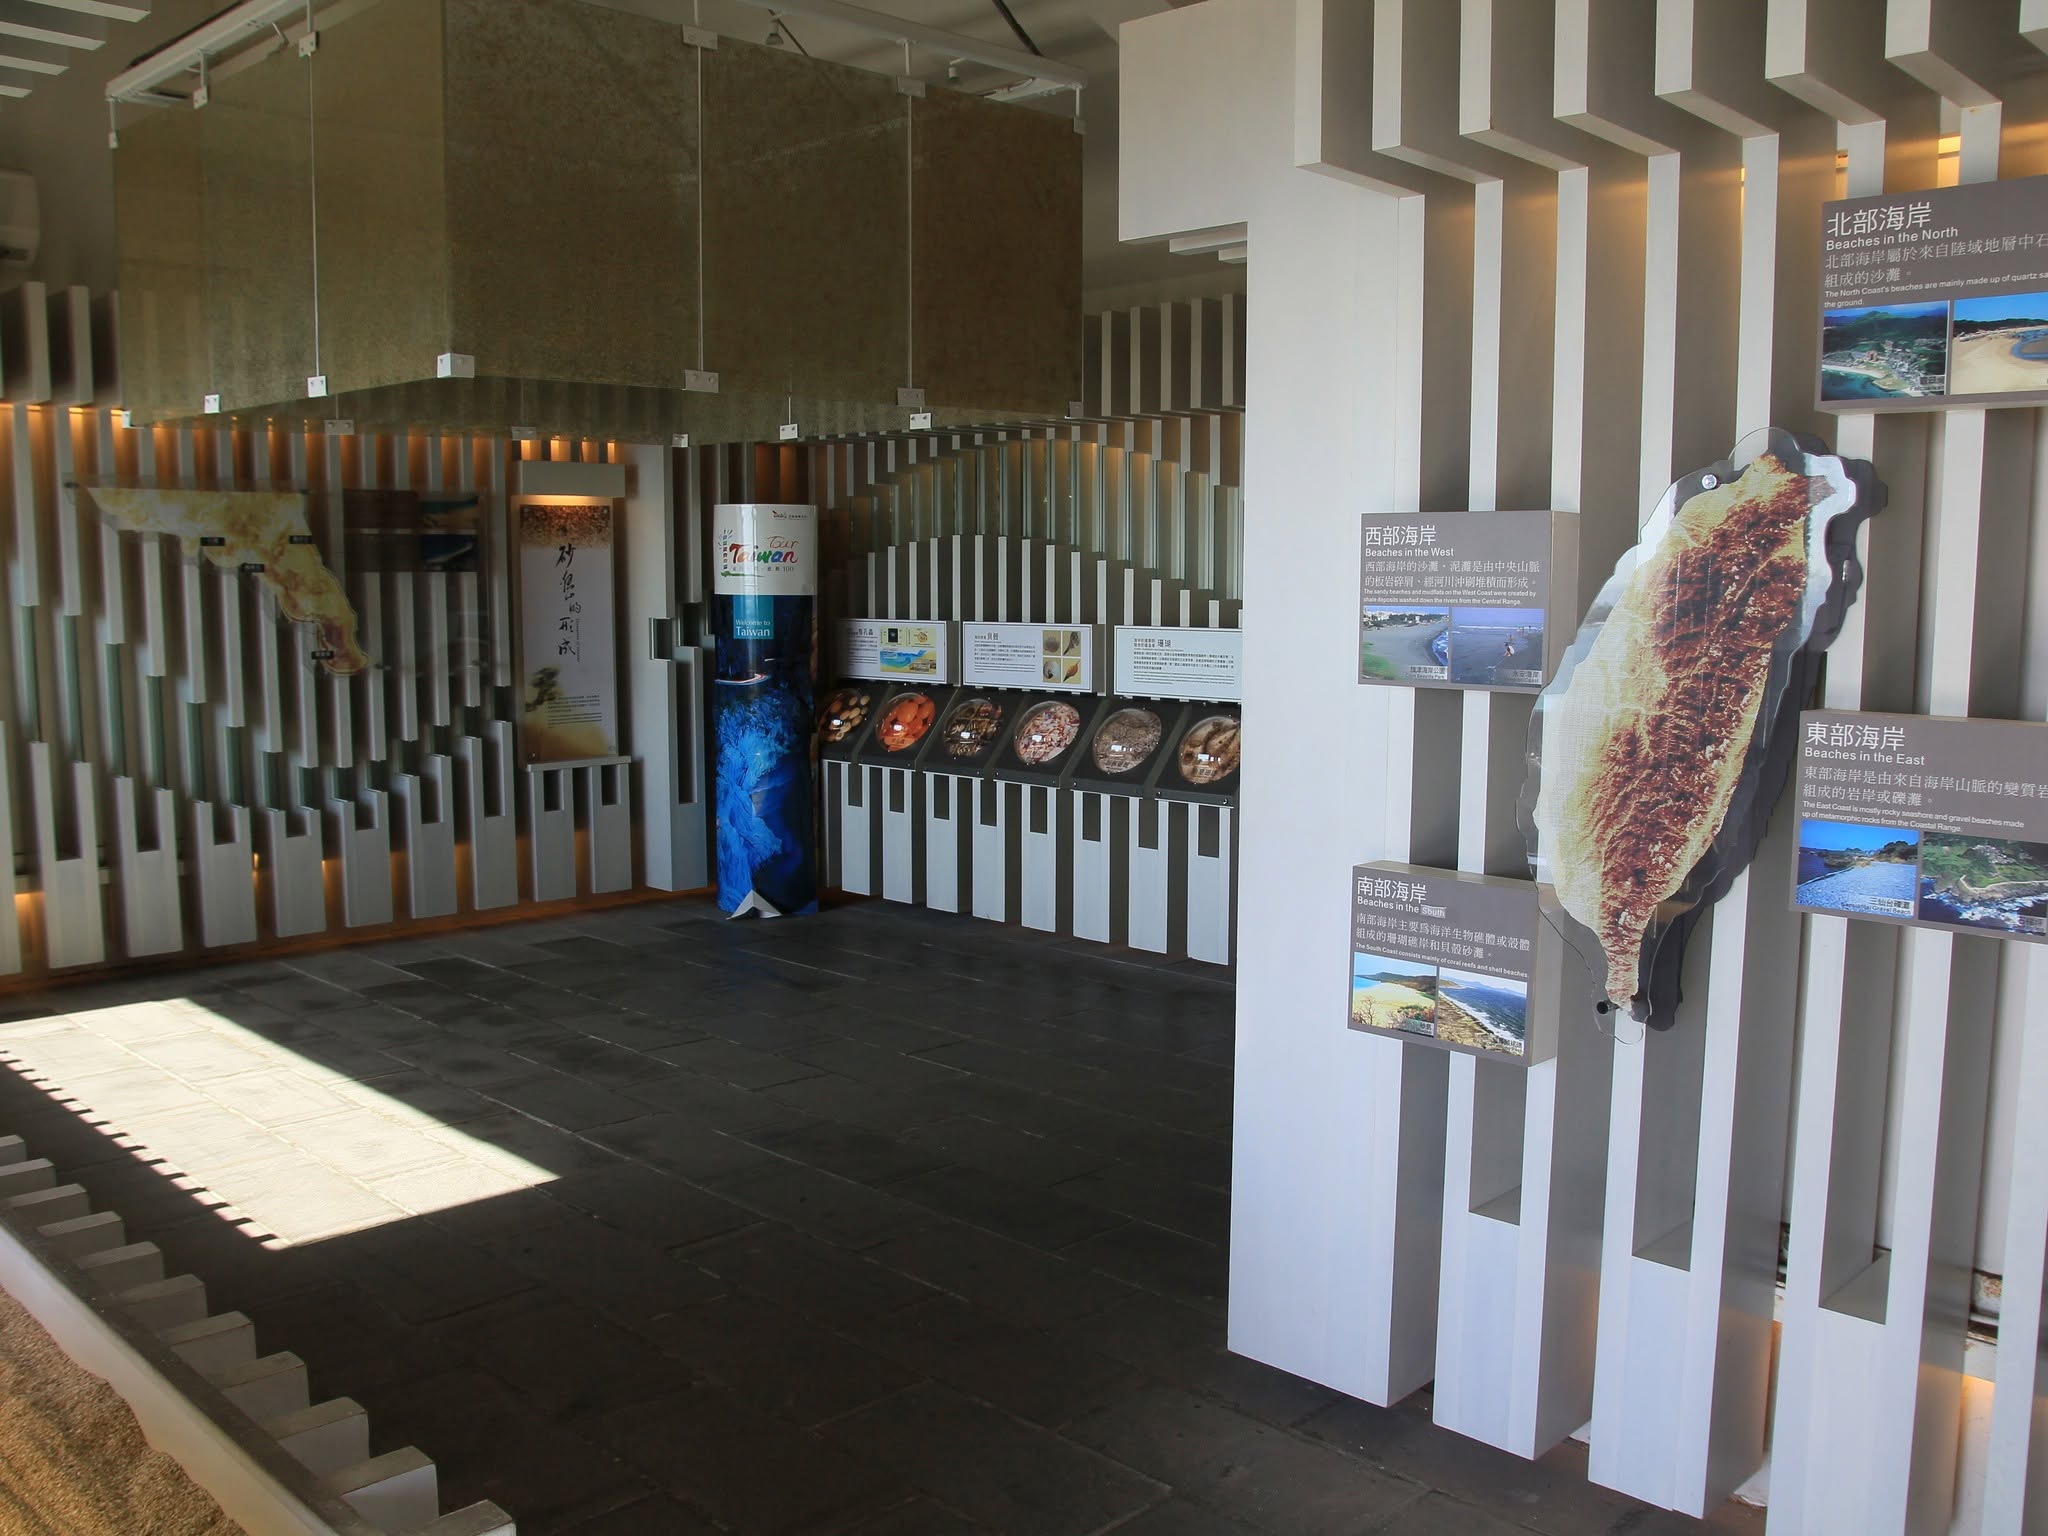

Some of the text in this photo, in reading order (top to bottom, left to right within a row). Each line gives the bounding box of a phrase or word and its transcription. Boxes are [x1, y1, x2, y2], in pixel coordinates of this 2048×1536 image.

[1827, 201, 1932, 237] 北部海岸
[1826, 226, 1958, 251] Beaches in the North
[1825, 290, 1838, 298] The
[1840, 288, 1860, 297] North
[1861, 286, 1889, 295] Coast's
[1890, 283, 1923, 293] beaches
[1939, 279, 1964, 288] mainly
[1966, 276, 1988, 285] made
[1990, 276, 2000, 284] up
[2001, 274, 2010, 282] of
[2011, 272, 2037, 282] quartz
[1837, 299, 1864, 309] ground.
[1365, 524, 1437, 546] 西部海岸
[729, 543, 799, 563] Taiwan
[1365, 547, 1454, 557] Beaches in the West
[735, 626, 770, 637] Taiwan
[1805, 721, 1906, 751] 東部海岸
[1804, 747, 1925, 766] Beaches in the East
[1802, 801, 2025, 828] The East Coast is mostly rocky seashore and gravel beaches made
[1818, 812, 1860, 823] metamorphic
[1861, 816, 1880, 824] rocks
[1881, 817, 1896, 825] from
[1897, 819, 1908, 827] the
[1909, 820, 1937, 830] Coastal
[1937, 823, 1963, 833] Range.
[1357, 876, 1427, 904] 南部海岸
[1357, 895, 1446, 917] Beaches in the South
[1366, 944, 1381, 952] South
[1382, 947, 1398, 955] Coast
[1398, 950, 1421, 959] consists
[1421, 954, 1440, 963] mainly
